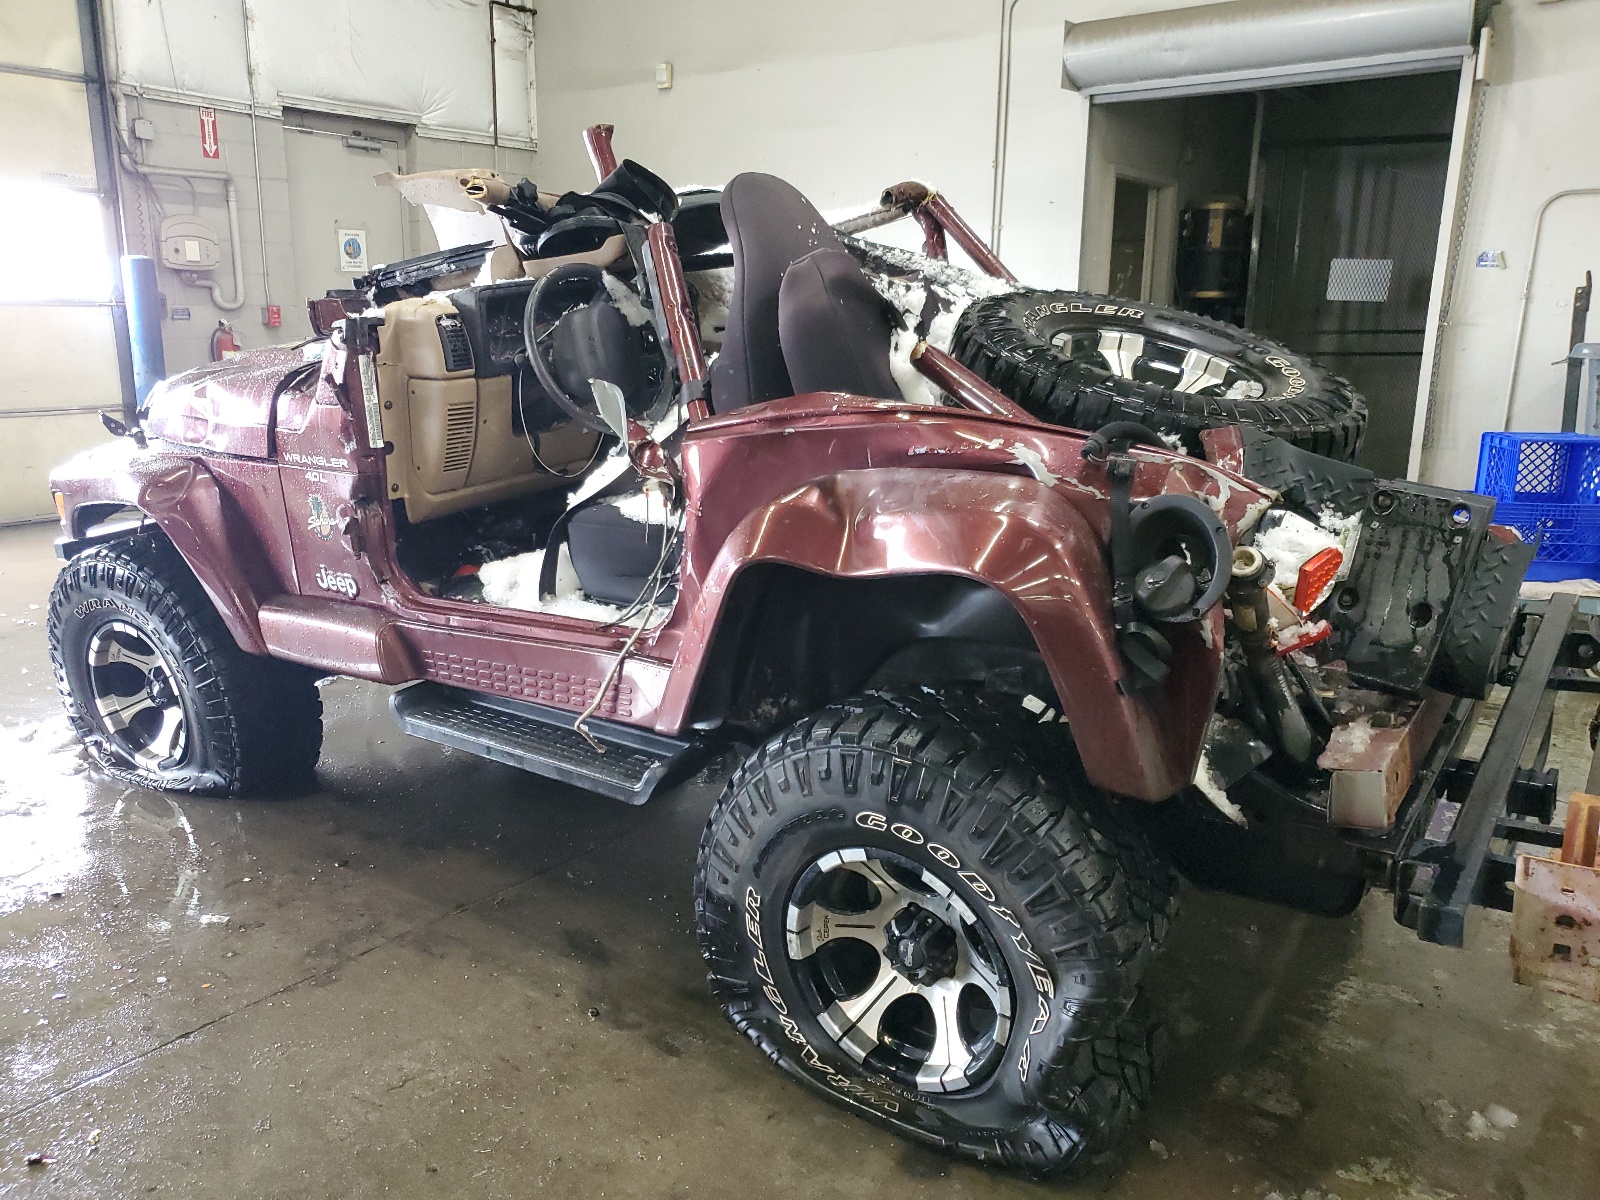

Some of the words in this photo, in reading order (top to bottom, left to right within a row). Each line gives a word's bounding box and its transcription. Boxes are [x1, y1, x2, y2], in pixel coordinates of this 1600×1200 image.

[202, 110, 213, 118] FIRE
[282, 451, 349, 469] WRANGLER
[315, 566, 357, 598] Jeep
[855, 810, 1055, 1083] GOODYEAR
[745, 886, 900, 1113] WRANGLER
